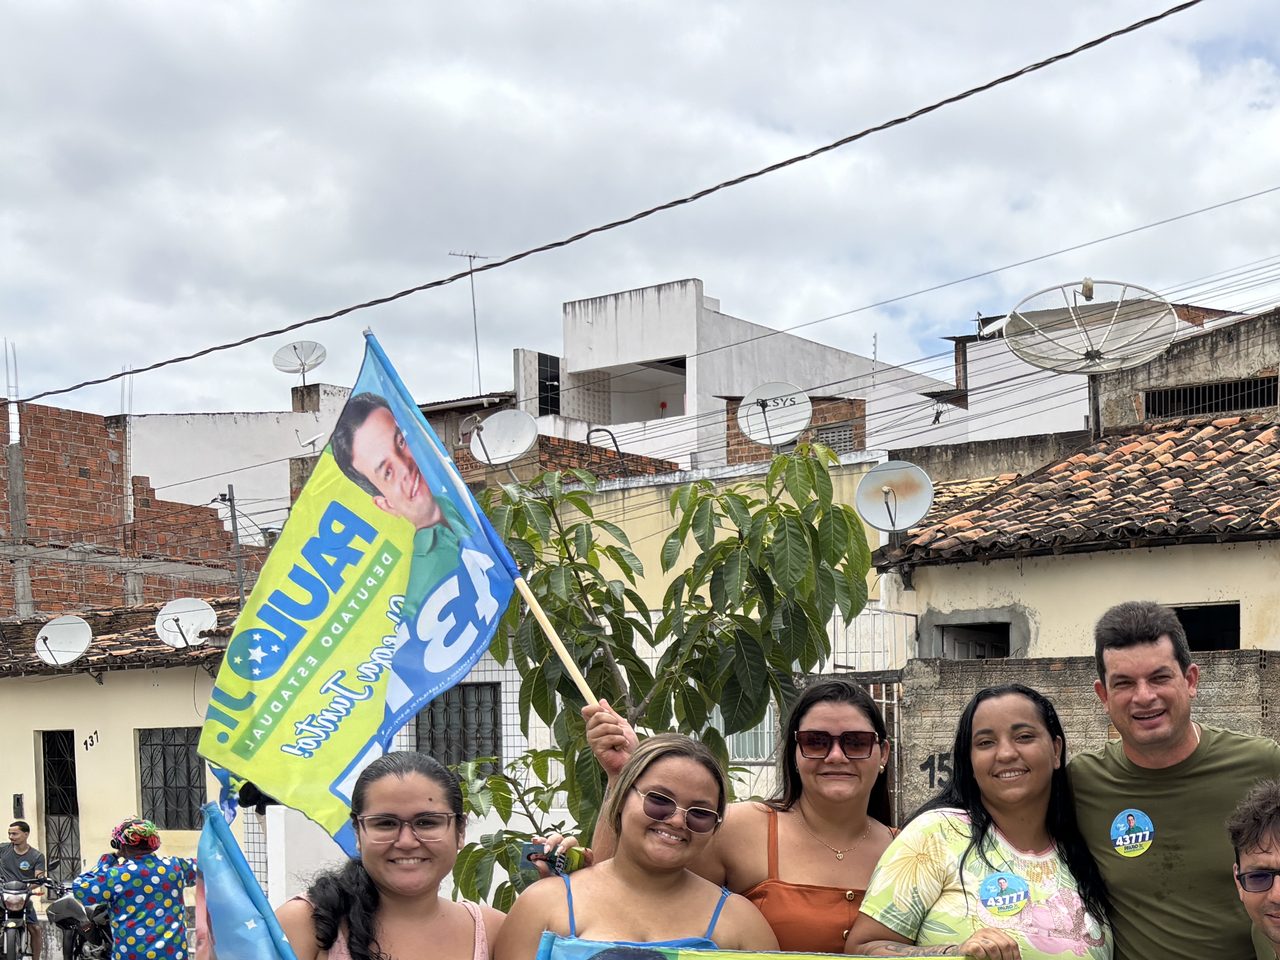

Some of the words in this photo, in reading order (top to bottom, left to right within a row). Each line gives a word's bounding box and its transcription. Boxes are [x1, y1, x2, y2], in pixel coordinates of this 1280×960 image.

[83, 730, 100, 752] 137
[1115, 831, 1151, 847] 43777
[987, 891, 1025, 907] 43777
